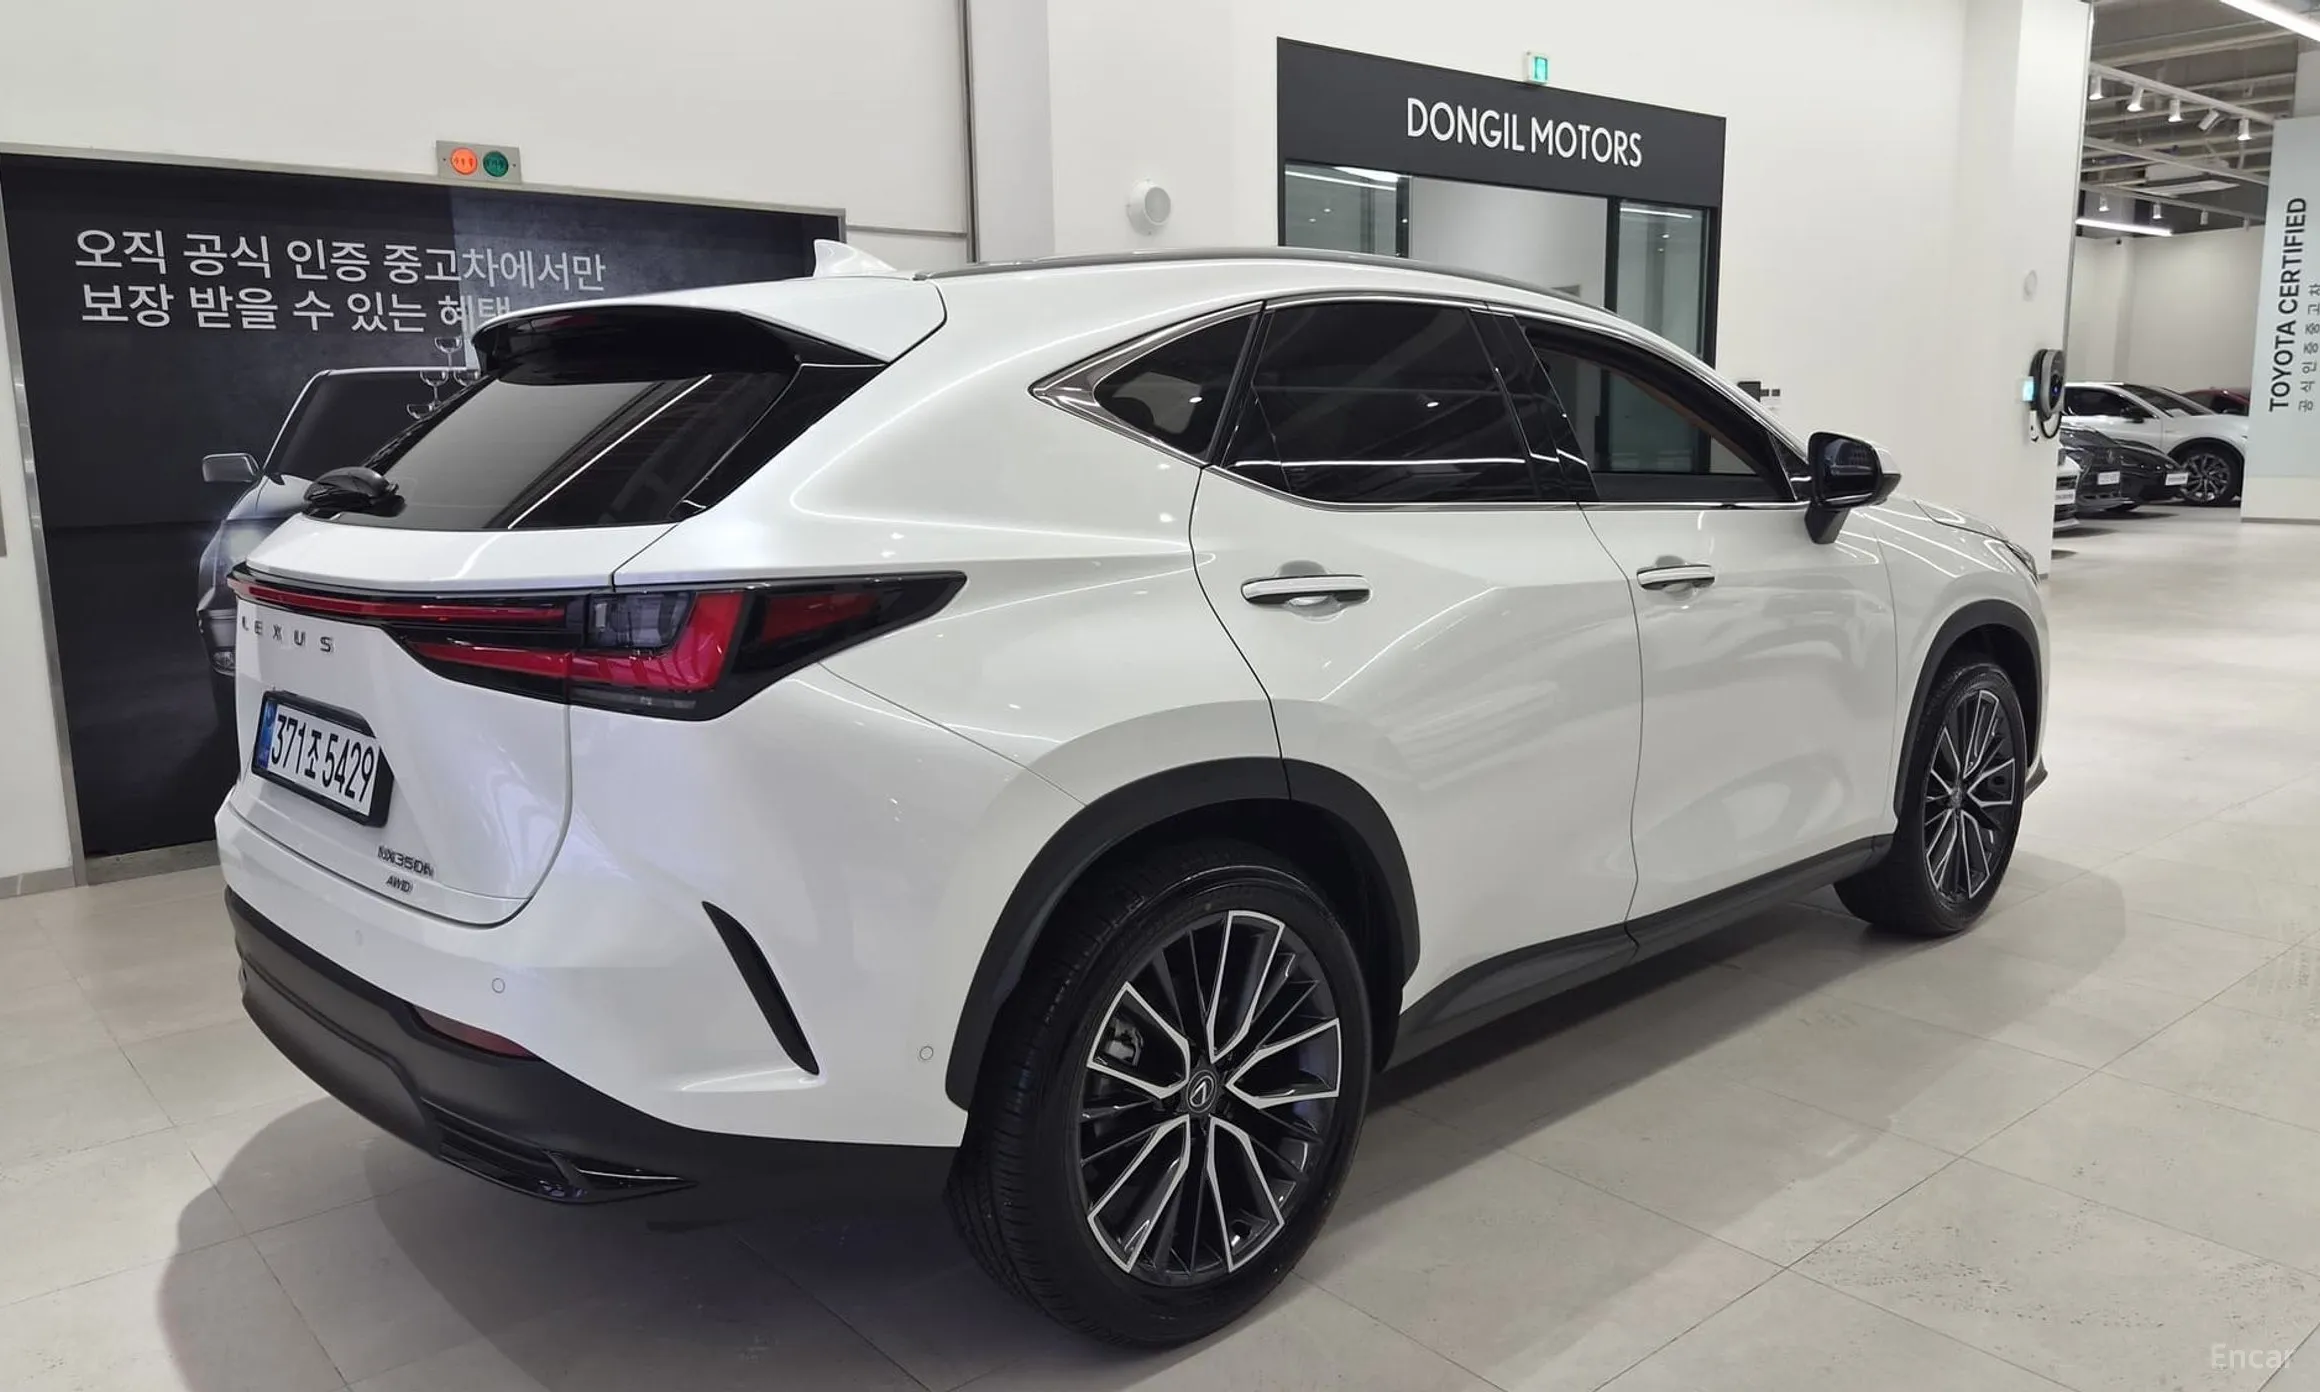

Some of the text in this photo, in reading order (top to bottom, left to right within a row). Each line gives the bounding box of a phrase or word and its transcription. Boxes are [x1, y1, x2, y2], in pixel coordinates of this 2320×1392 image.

[1407, 97, 1643, 168] DONGIL MOTORS
[75, 229, 607, 291] 오직 공식 인증 중고차에서만
[82, 283, 174, 327] 보장
[189, 285, 278, 330] 받을
[292, 290, 334, 331] 수
[347, 291, 427, 333] 있는
[2269, 197, 2307, 412] TOYOTA CERTIFIED
[242, 615, 334, 653] LEXUS
[271, 713, 375, 803] 371조 5429
[386, 875, 414, 893] AWD
